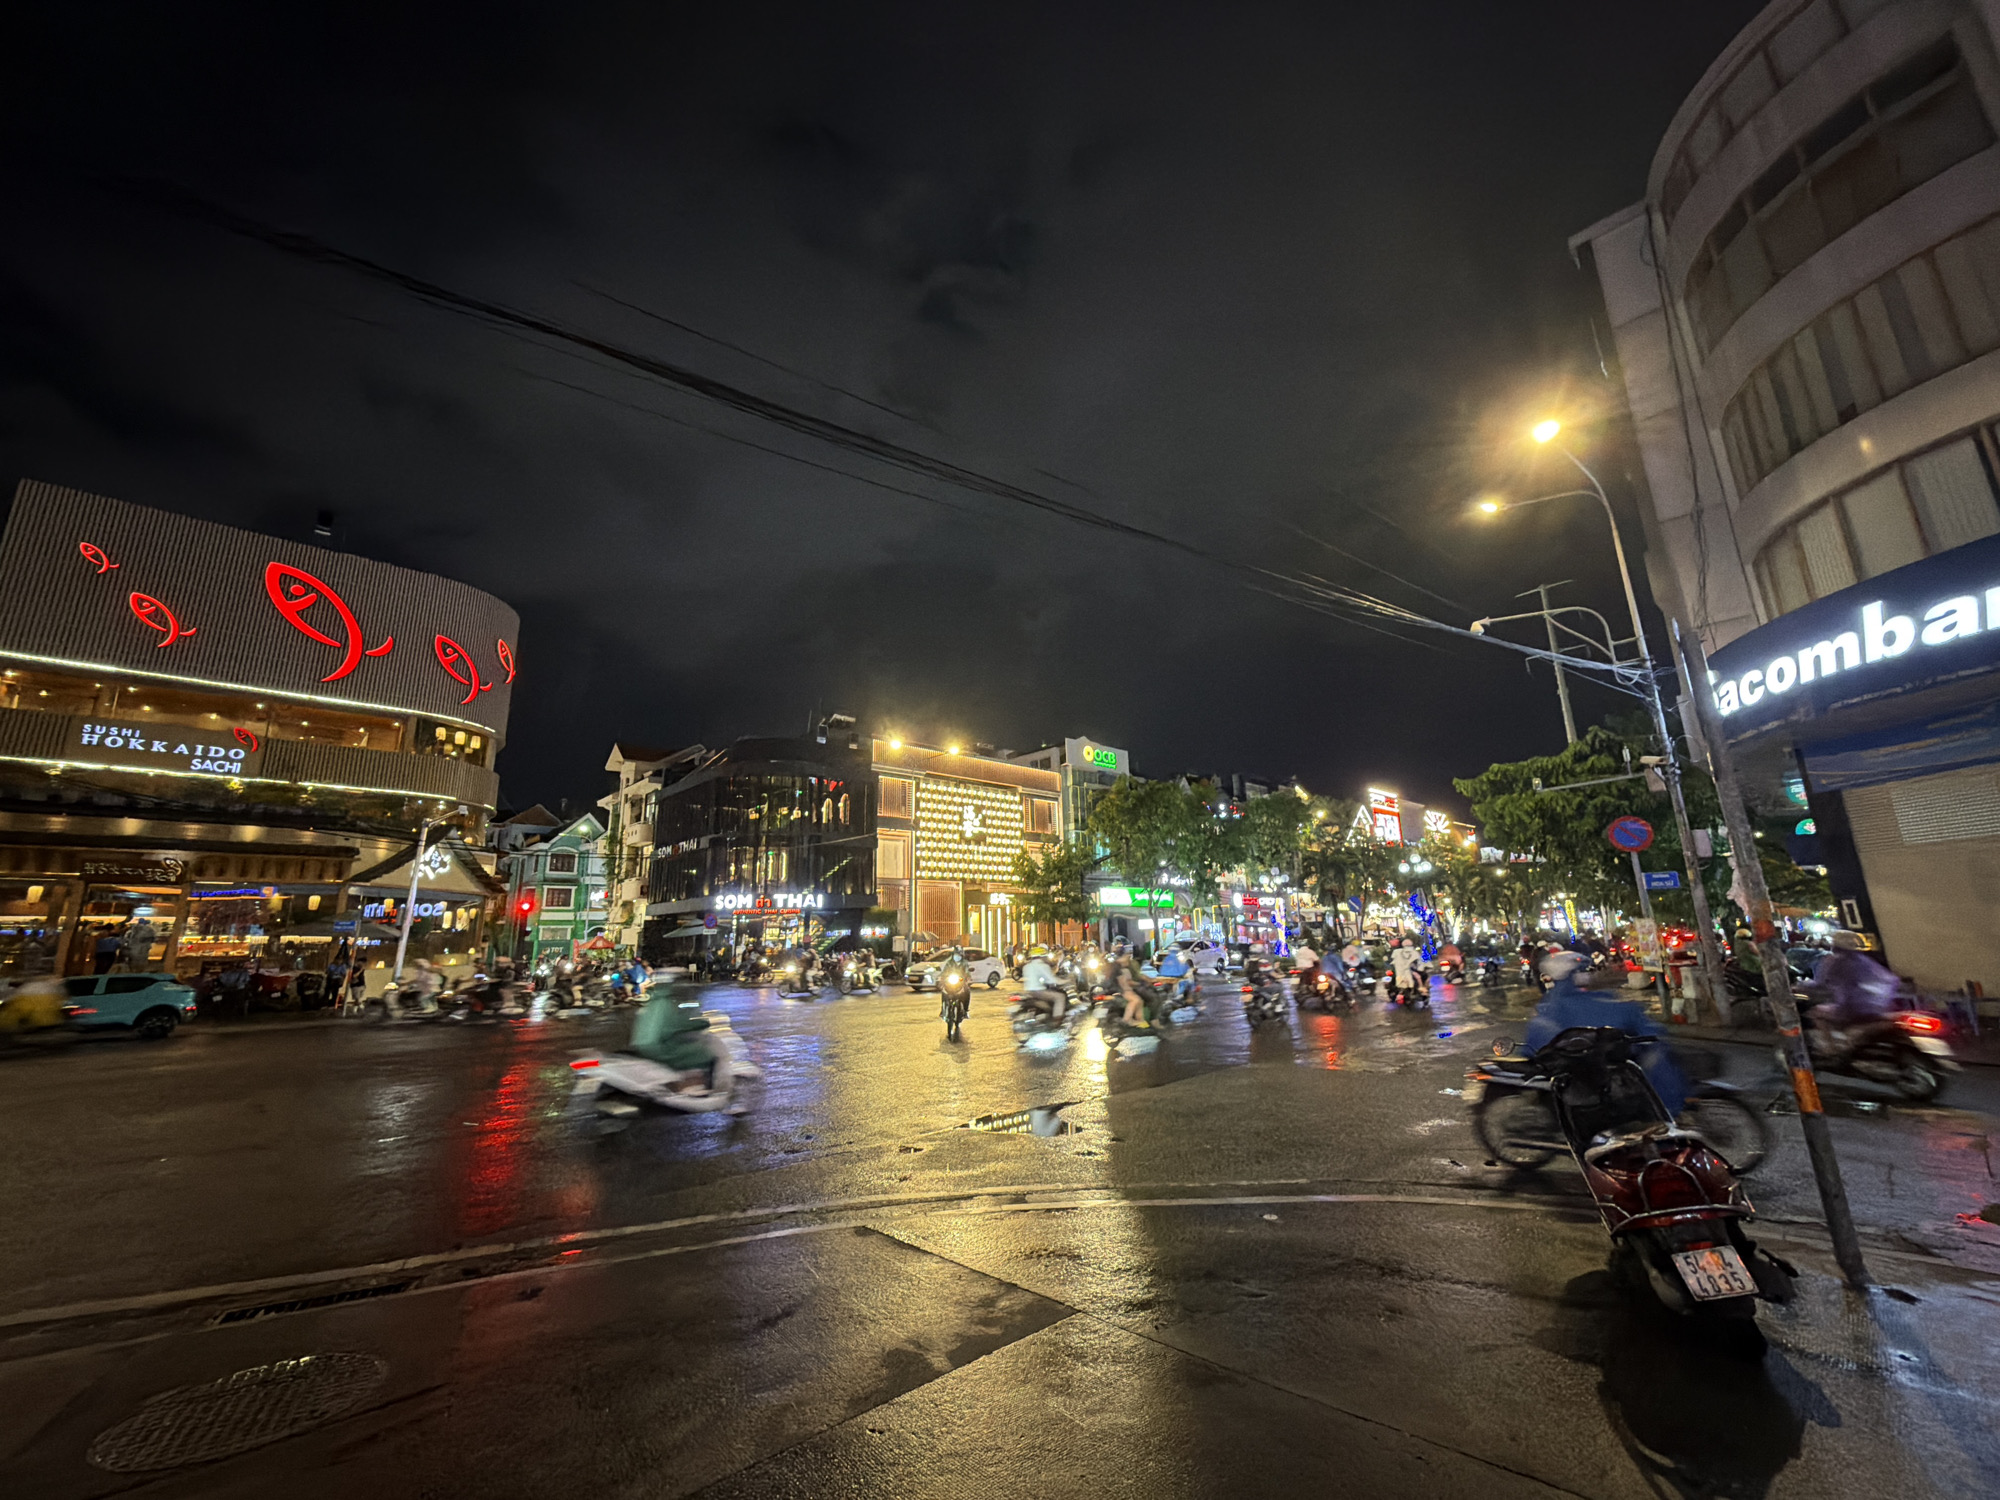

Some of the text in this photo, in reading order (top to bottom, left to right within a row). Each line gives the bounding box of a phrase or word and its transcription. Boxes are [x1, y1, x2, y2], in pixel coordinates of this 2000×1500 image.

[1707, 586, 2000, 716] acomba
[82, 724, 140, 738] SUSHI
[81, 733, 245, 760] HOKKAIDO
[1094, 749, 1117, 765] OCB
[190, 758, 242, 774] SACHI
[679, 837, 698, 853] THAI
[715, 894, 753, 909] SOM
[773, 893, 823, 908] THAI
